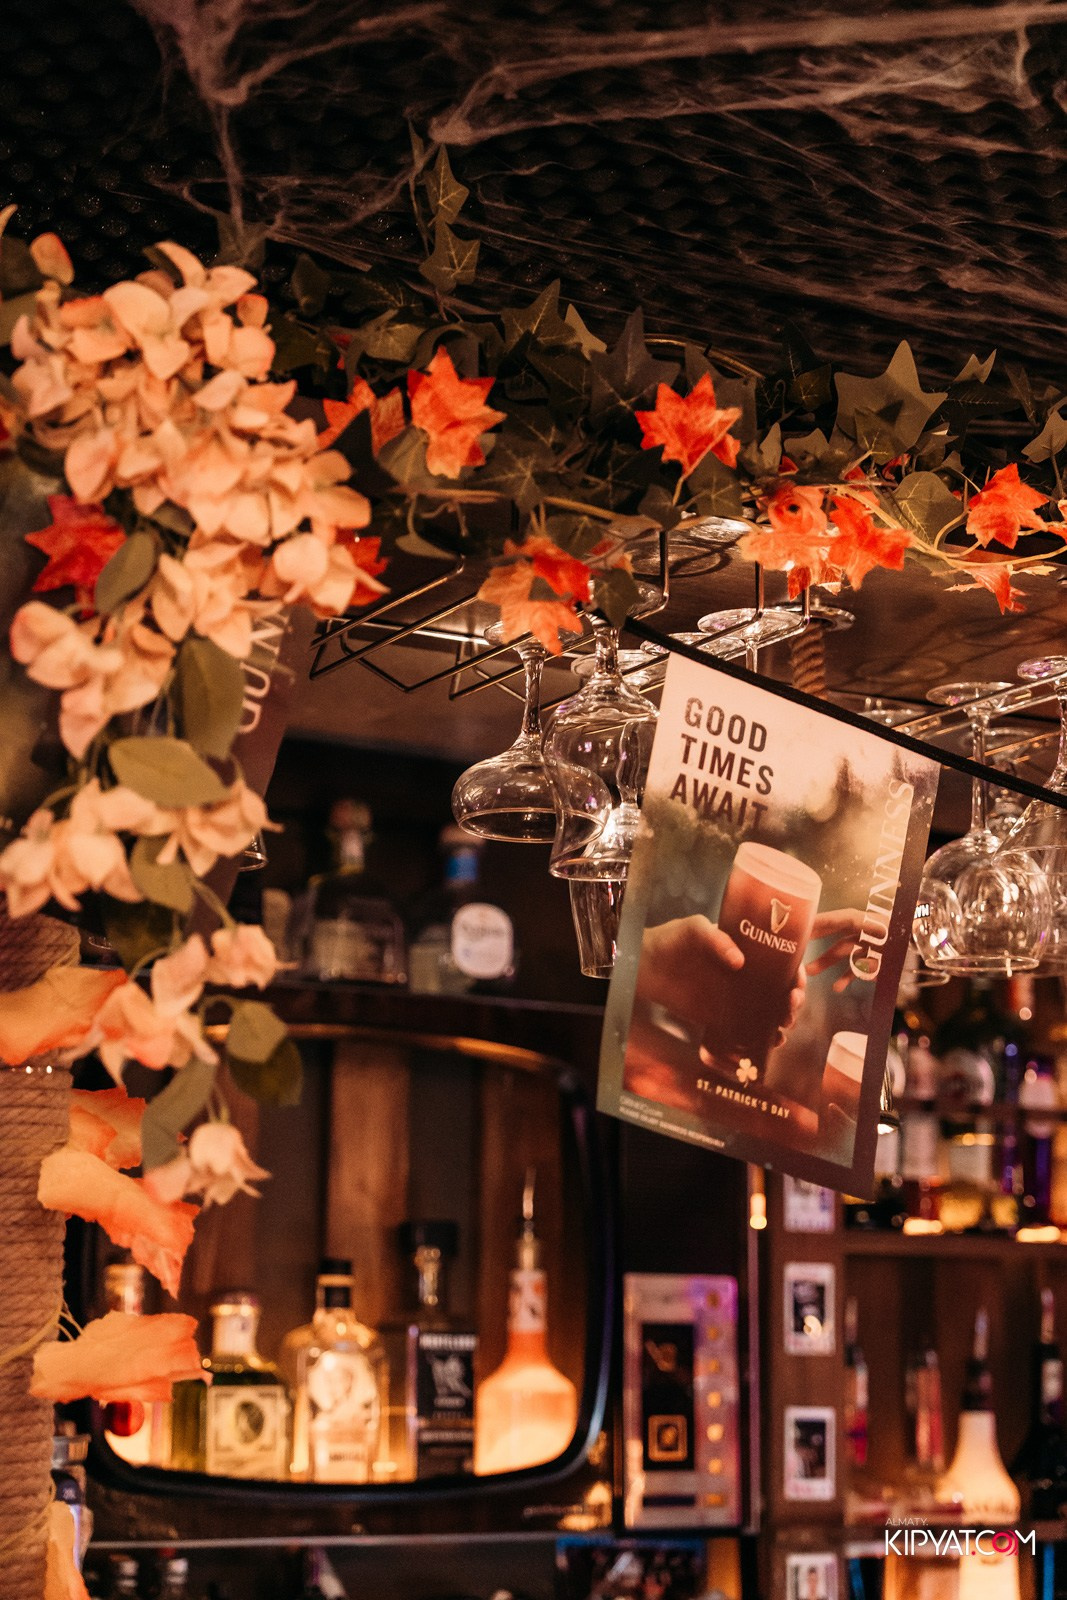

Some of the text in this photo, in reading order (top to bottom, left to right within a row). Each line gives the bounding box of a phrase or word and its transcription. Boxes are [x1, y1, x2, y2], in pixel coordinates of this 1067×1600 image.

[684, 697, 768, 753] GOOD
[680, 733, 775, 796] TIMES
[669, 773, 769, 829] AWAIT
[849, 779, 914, 981] GUINNESS
[739, 918, 798, 954] GUINNESS
[715, 1085, 768, 1111] PATRICK'S
[770, 1104, 790, 1119] DAY
